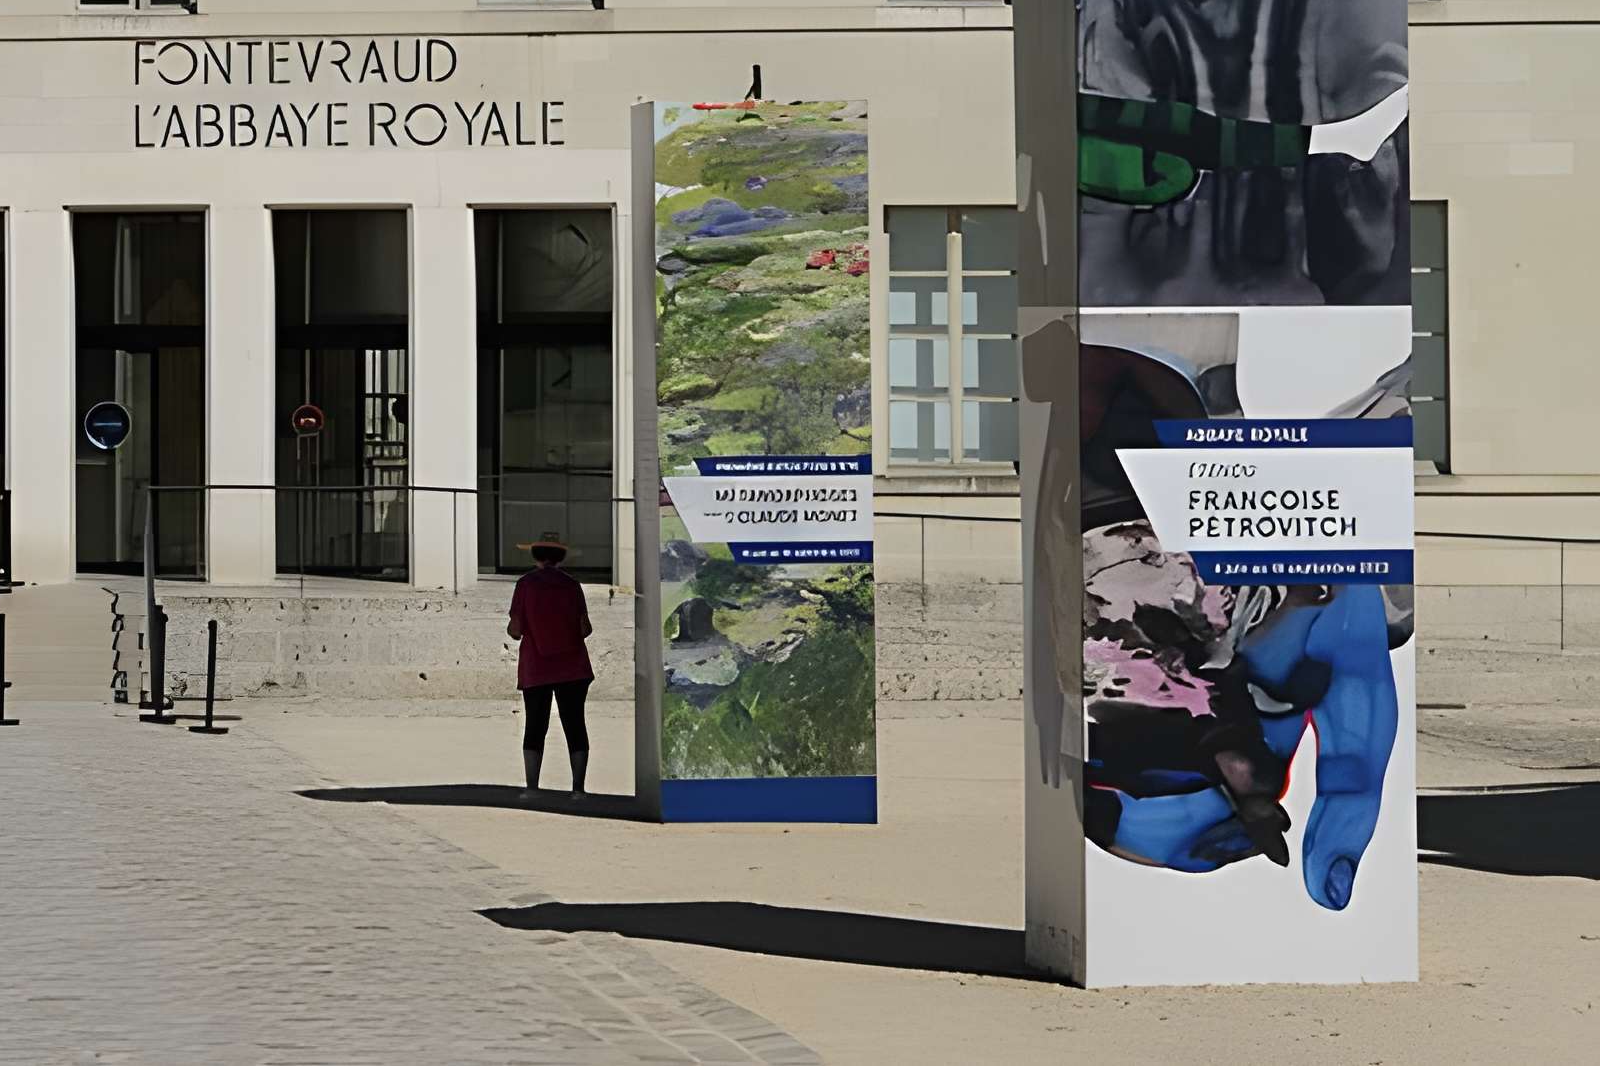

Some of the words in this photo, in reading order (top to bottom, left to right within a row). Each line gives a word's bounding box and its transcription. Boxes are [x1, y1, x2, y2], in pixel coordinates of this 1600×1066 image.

[134, 39, 457, 86] FONTEVRAUD
[134, 102, 349, 148] L'ABBAYE
[369, 101, 565, 148] ROYALE
